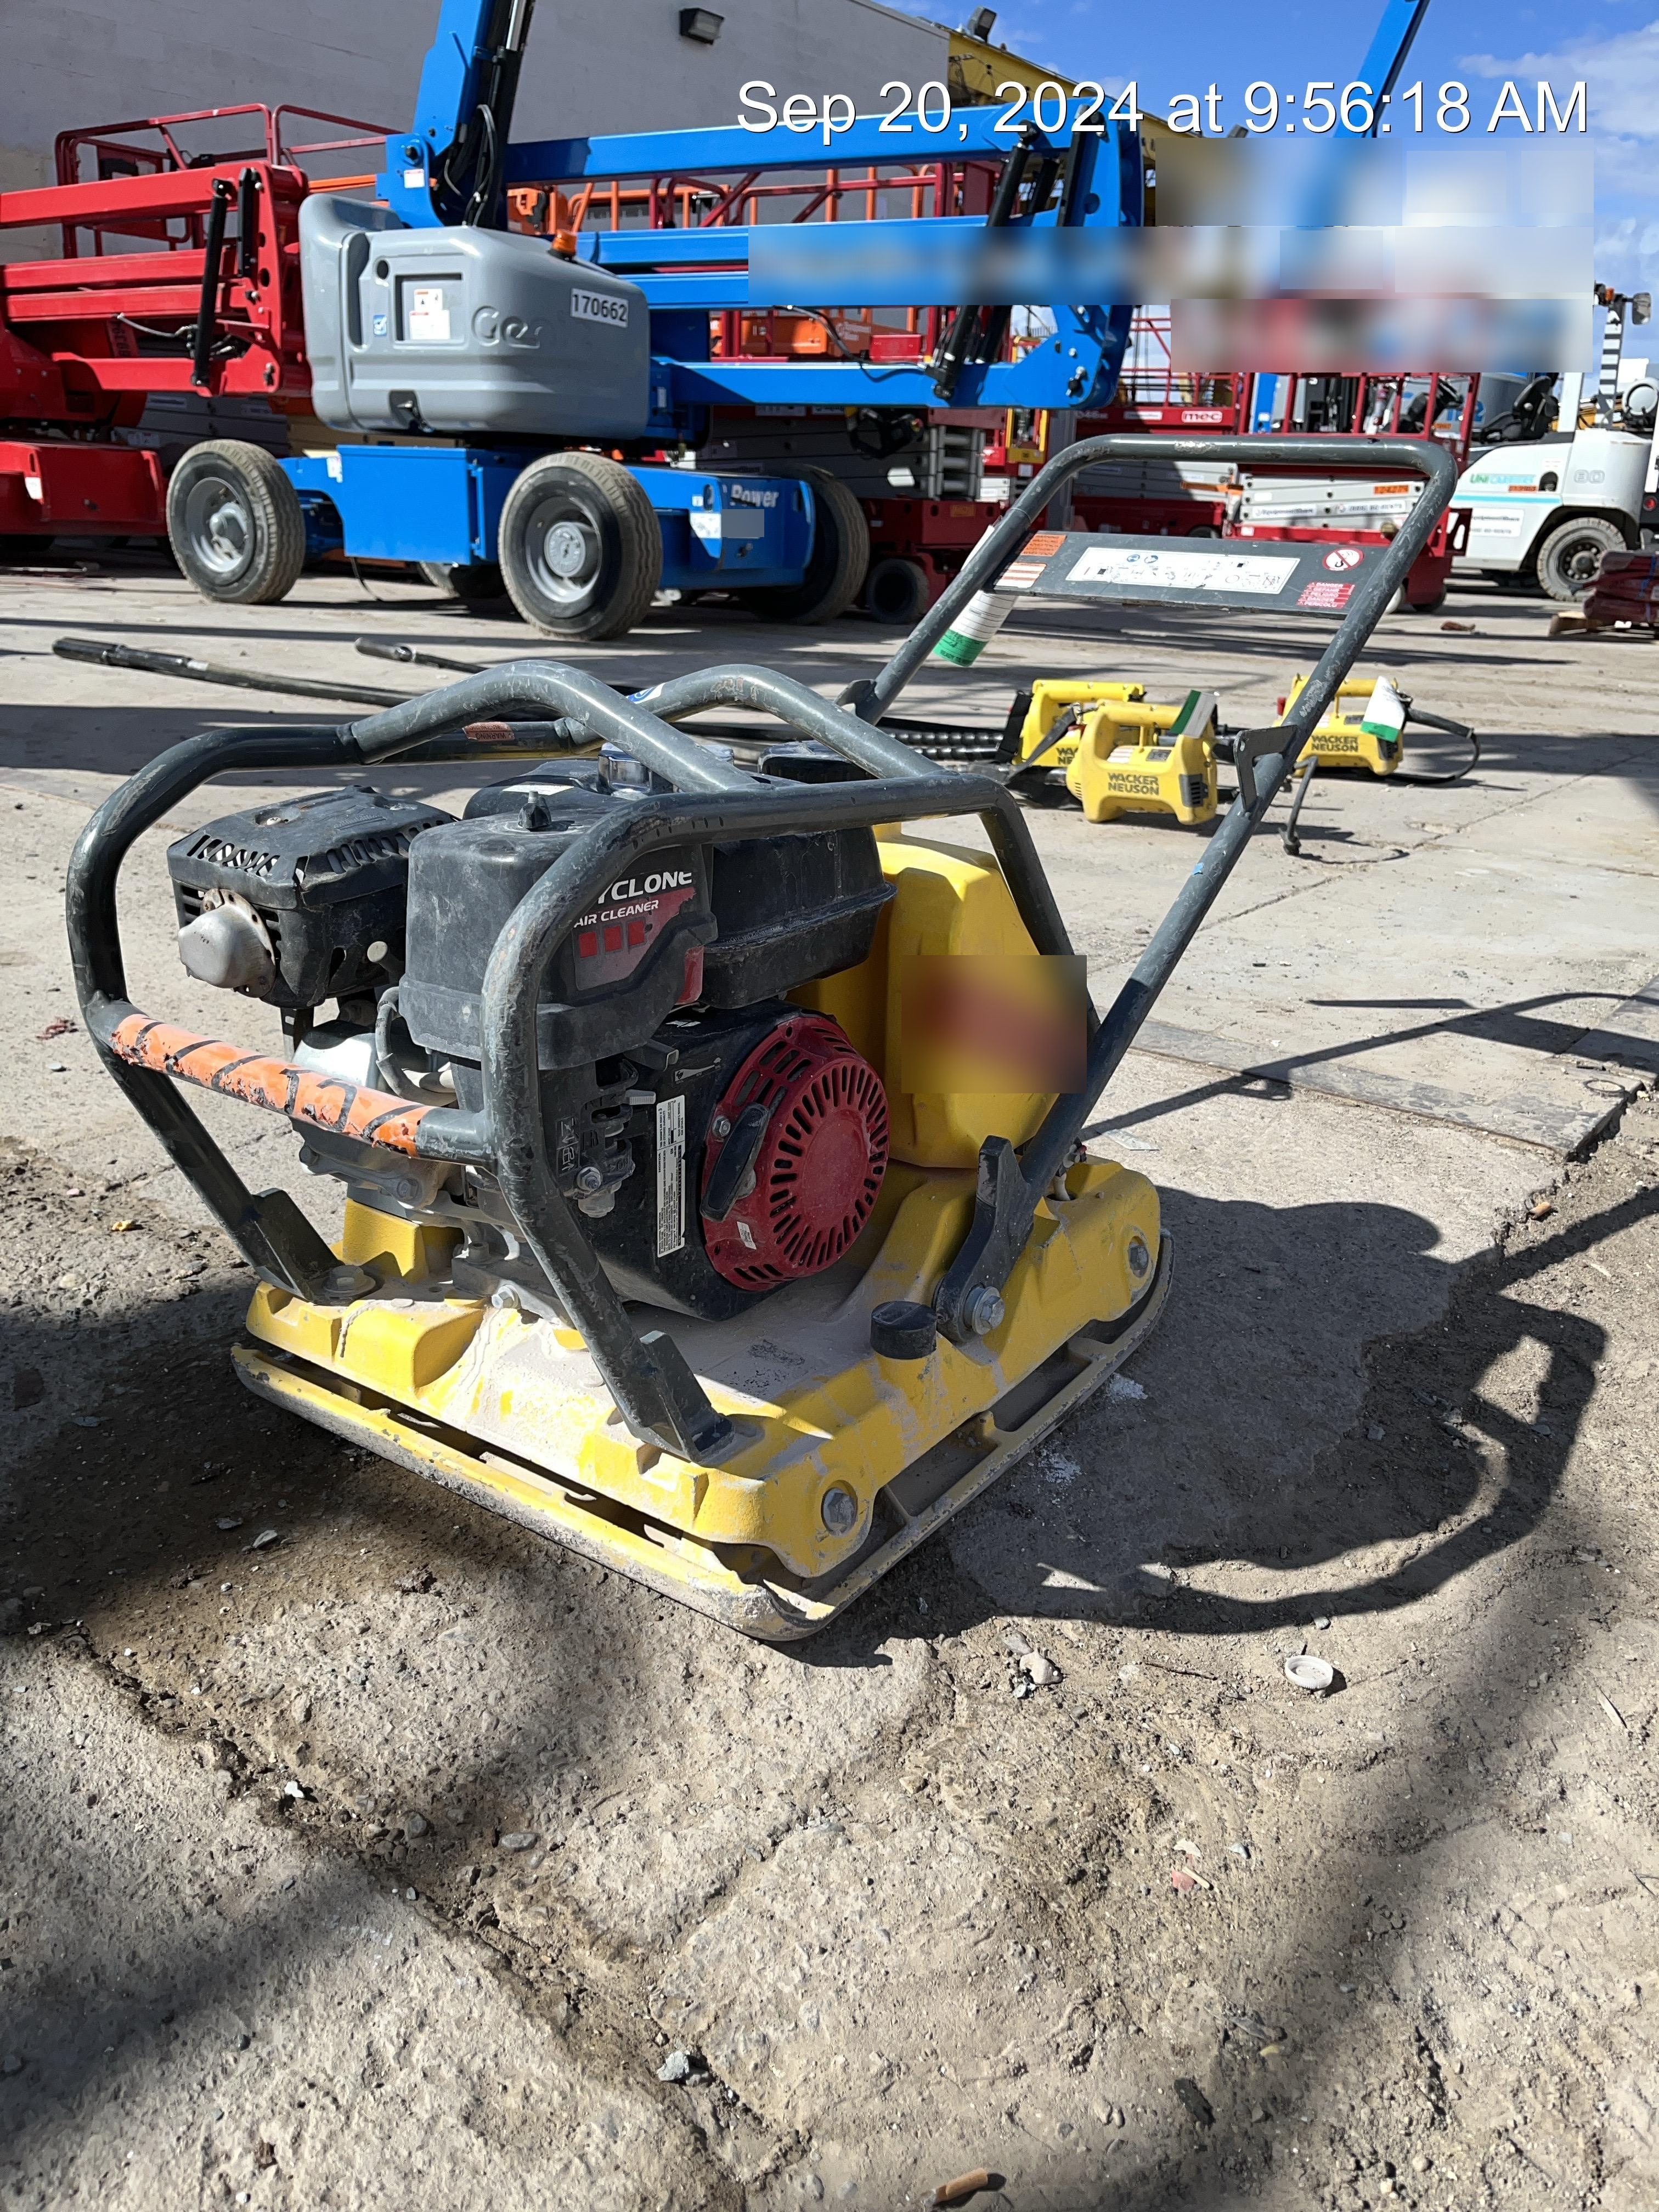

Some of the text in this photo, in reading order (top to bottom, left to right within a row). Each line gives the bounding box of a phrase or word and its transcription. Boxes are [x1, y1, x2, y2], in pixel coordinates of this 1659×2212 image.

[573, 294, 627, 321] 170662
[730, 484, 780, 508] Power
[1311, 735, 1358, 743] WACKER
[1312, 743, 1358, 752] NEUSON
[1108, 772, 1159, 786] WACKER
[1108, 782, 1159, 795] NEUSON
[598, 871, 692, 904] YCLONE
[574, 900, 659, 928] AIR CLEANER
